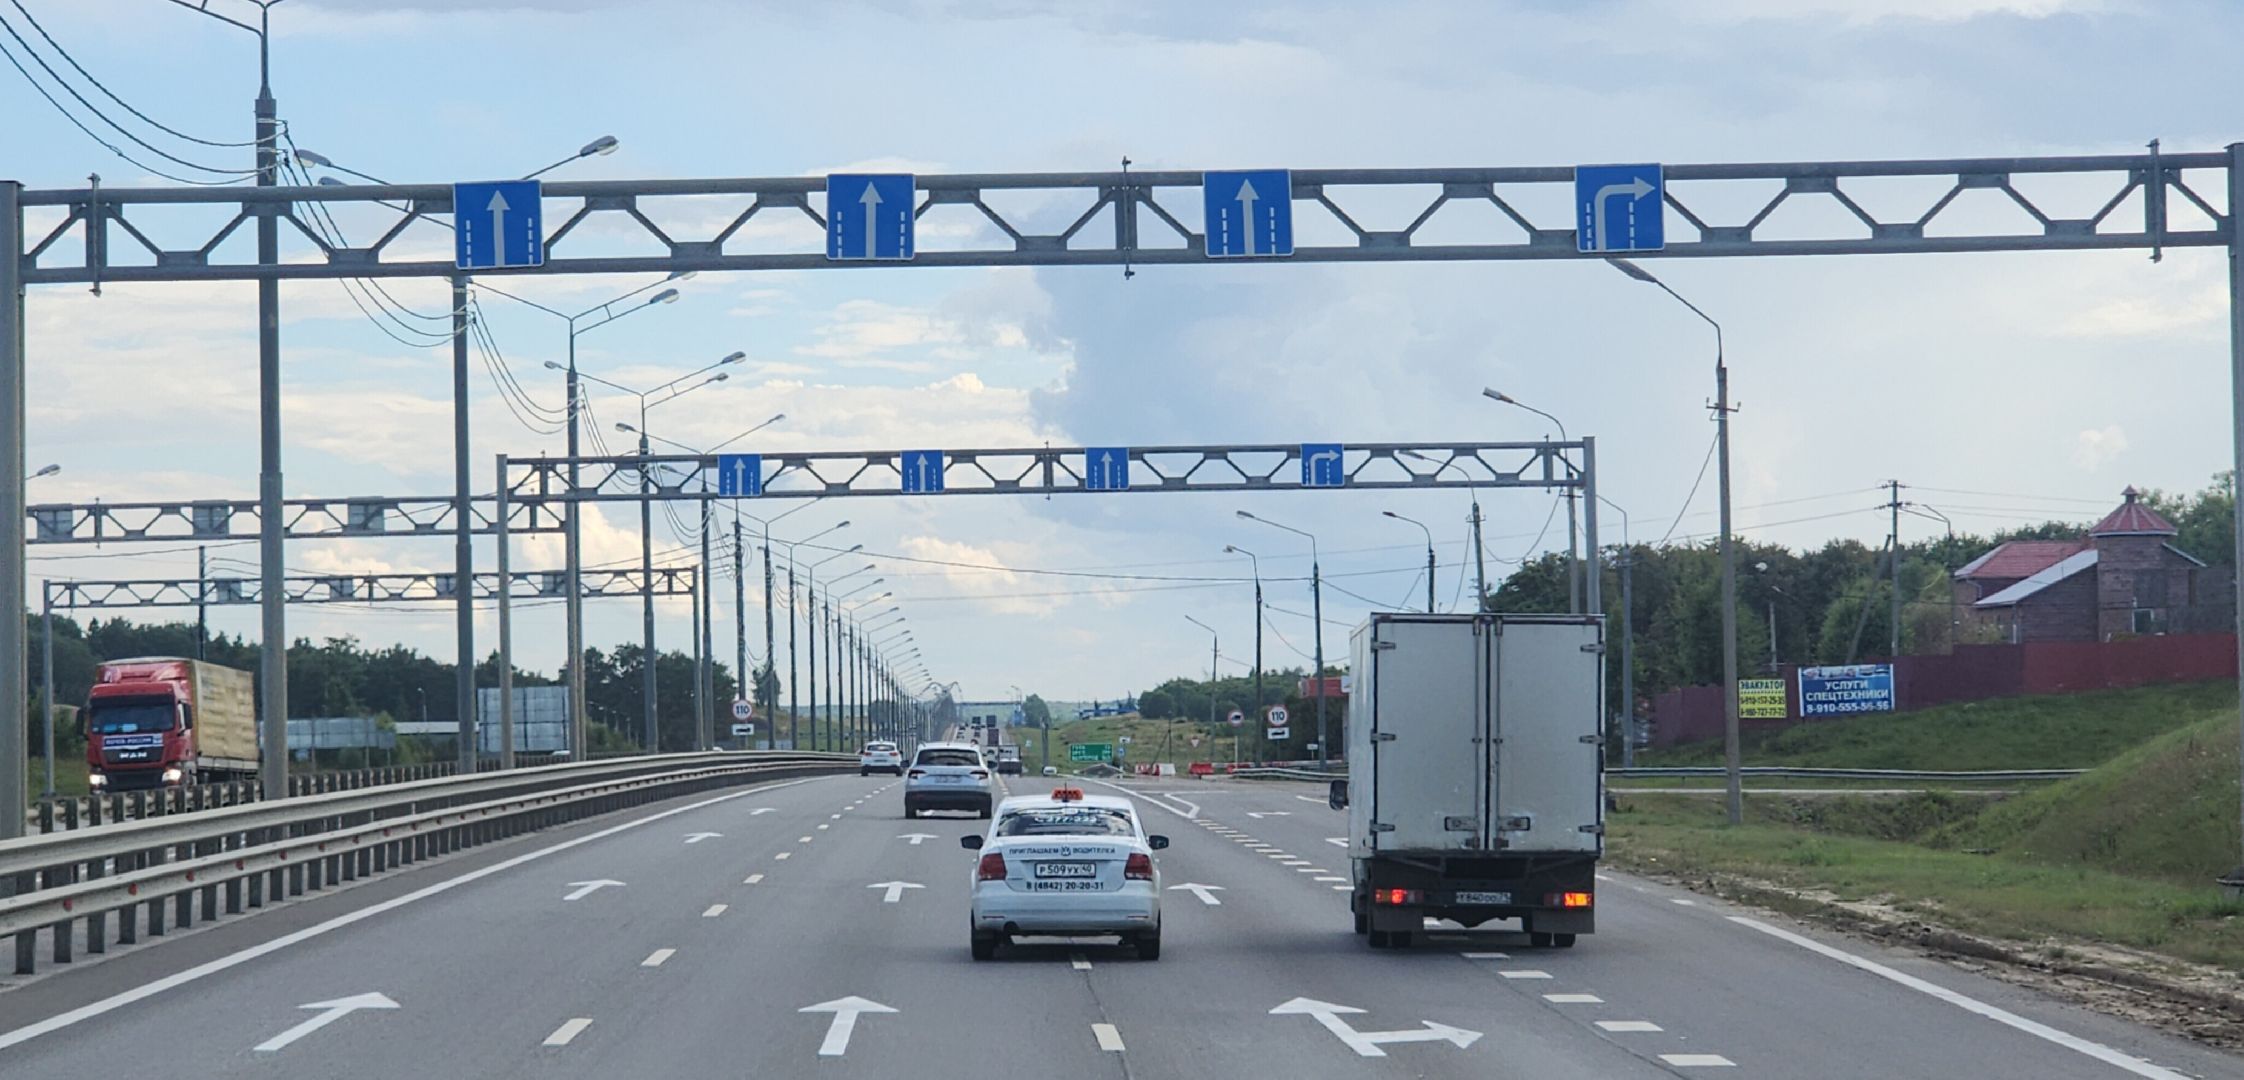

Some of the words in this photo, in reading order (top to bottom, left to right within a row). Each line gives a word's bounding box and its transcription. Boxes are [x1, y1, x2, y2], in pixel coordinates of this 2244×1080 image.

[1825, 680, 1868, 690] УСЛУГИ
[1805, 689, 1889, 702] СПЕЦТЕХНИКИ
[736, 705, 750, 714] 110
[1271, 711, 1285, 720] 110
[119, 751, 147, 759] MAN
[1009, 847, 1059, 855] ПРИГЛАШАЕМ
[1034, 881, 1062, 891] (4842)
[1065, 881, 1104, 890] 20-20-31
